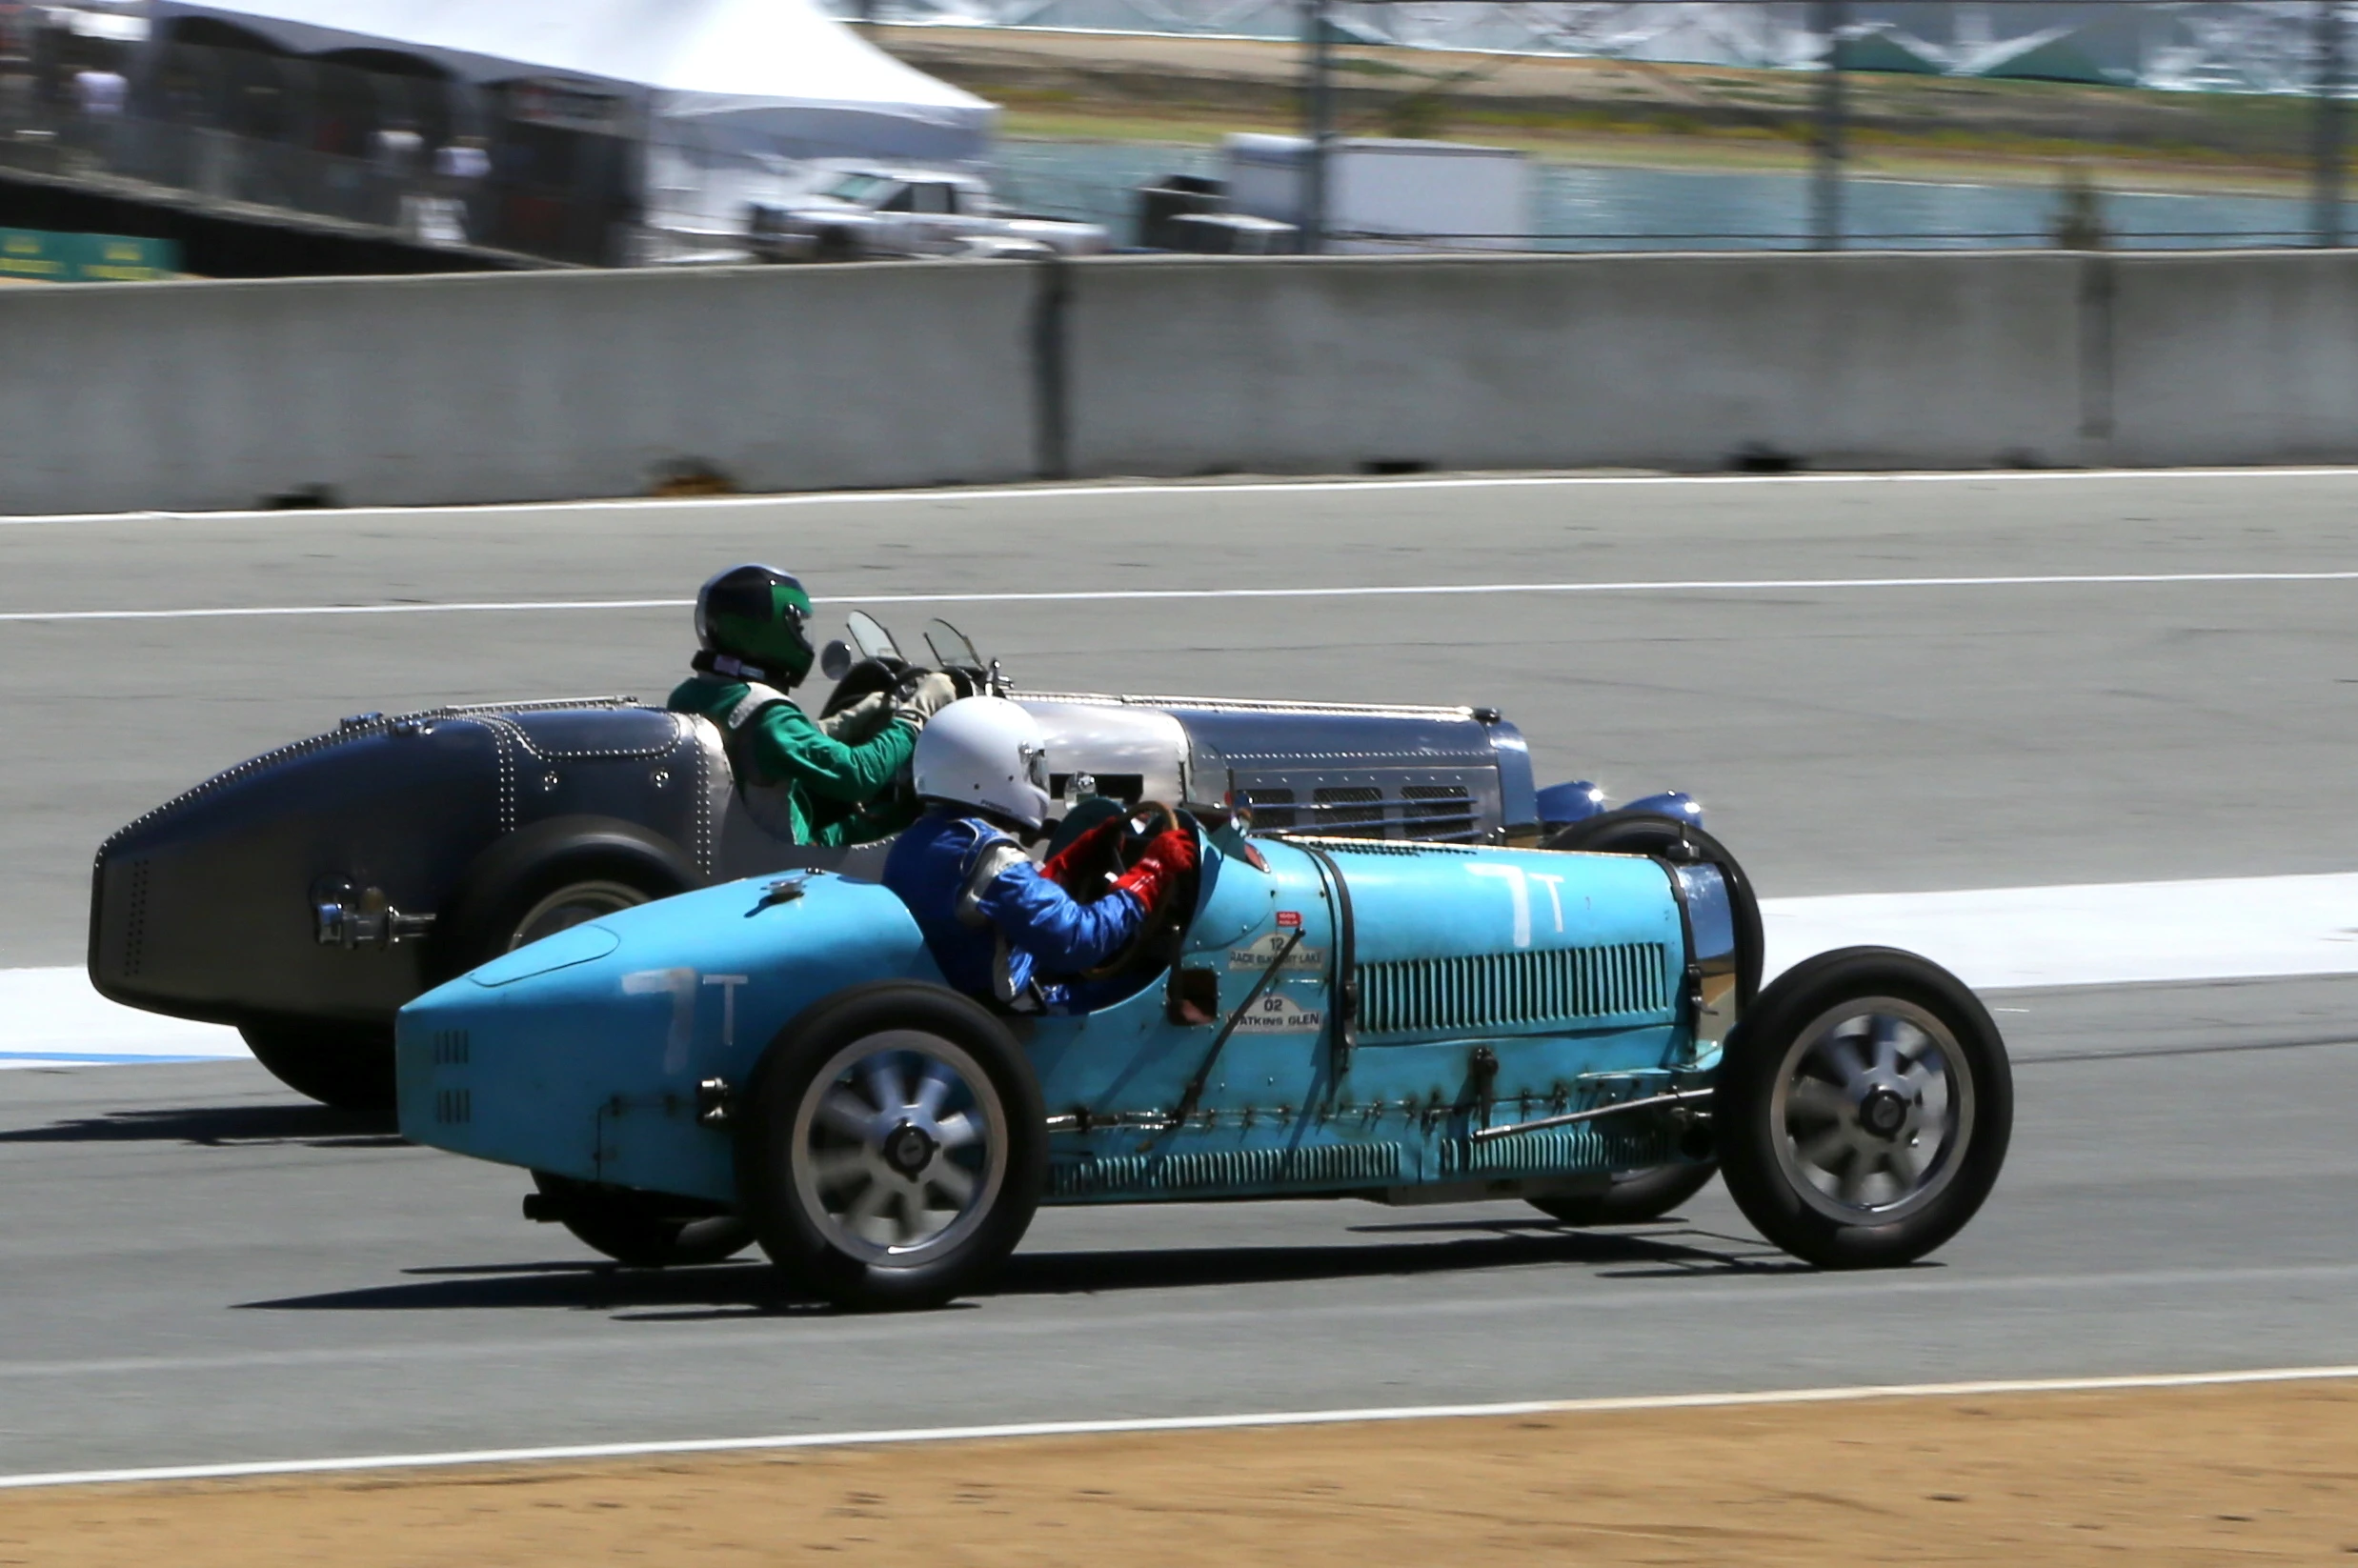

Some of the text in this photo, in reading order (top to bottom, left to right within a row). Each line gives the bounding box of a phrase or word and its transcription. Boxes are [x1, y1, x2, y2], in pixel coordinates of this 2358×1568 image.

[1463, 863, 1564, 948] 7T
[1270, 936, 1284, 951] 12
[1264, 998, 1282, 1012] 02
[621, 967, 748, 1075] 7T
[1288, 1013, 1320, 1026] GLEN
